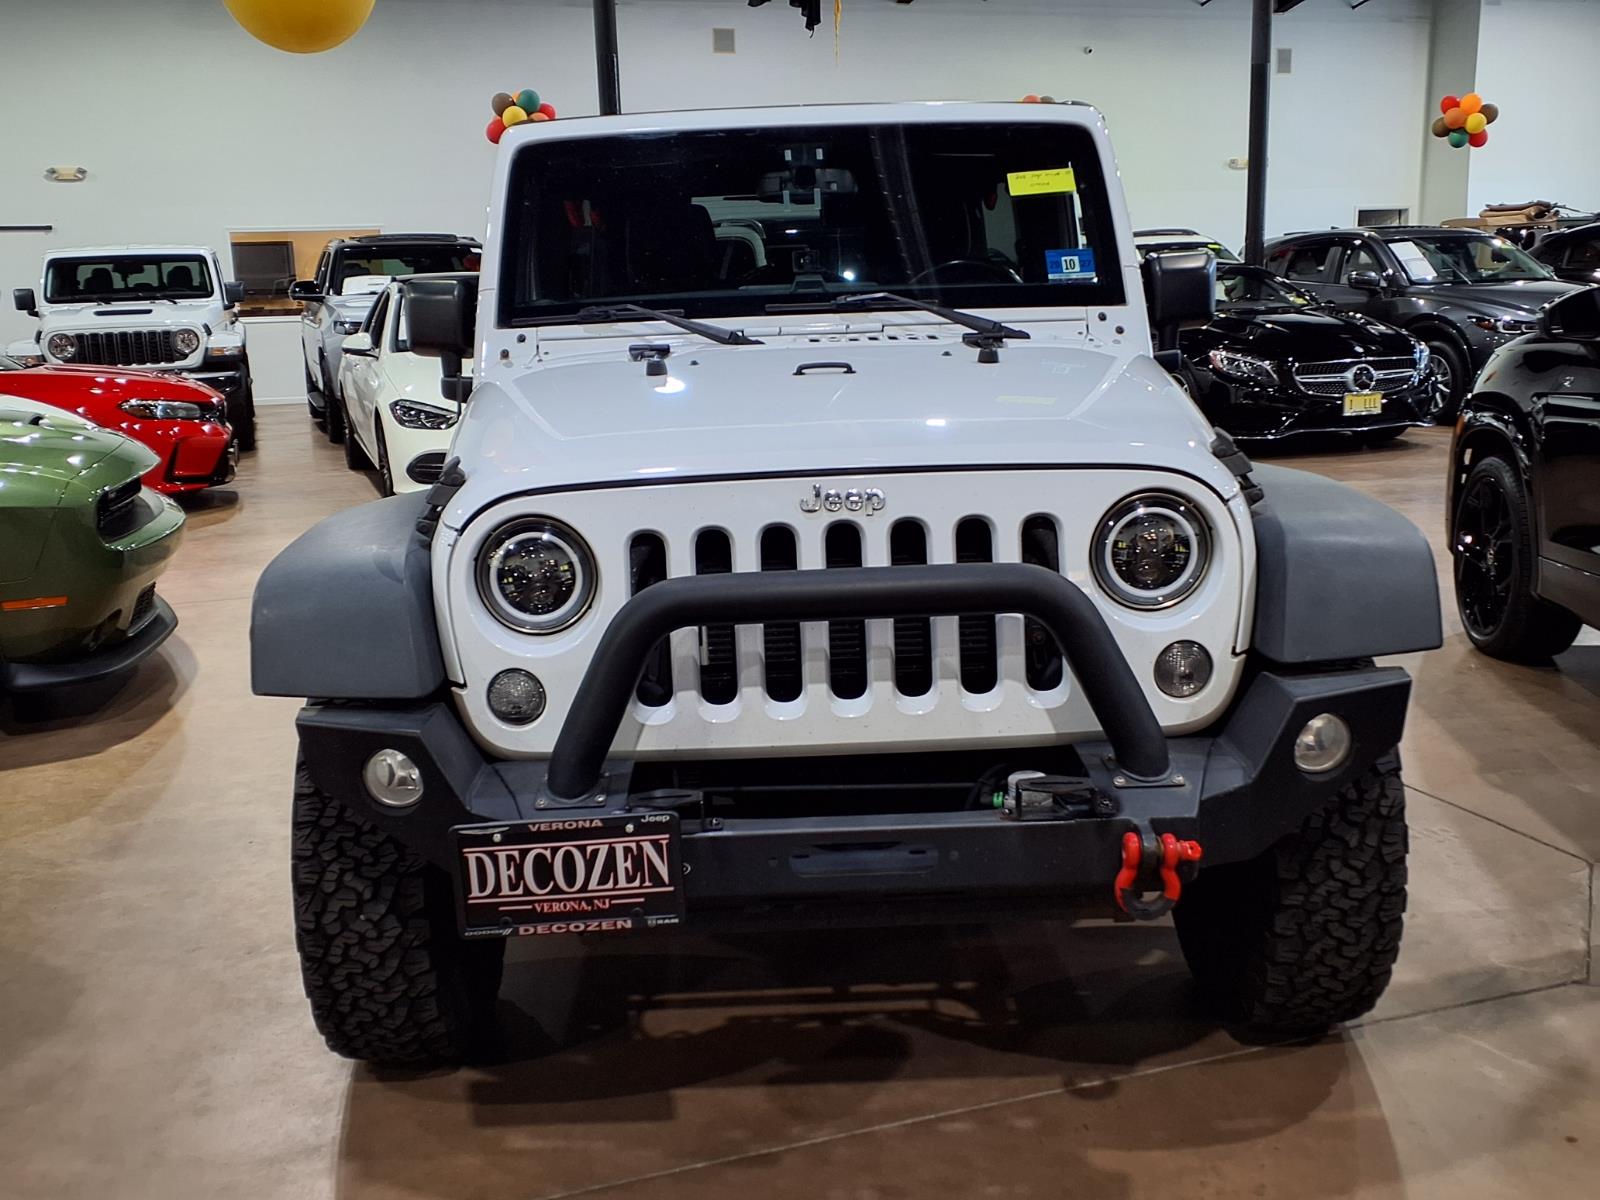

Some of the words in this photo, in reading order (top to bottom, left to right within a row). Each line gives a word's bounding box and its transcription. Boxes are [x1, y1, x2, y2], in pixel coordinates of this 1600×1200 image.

[1063, 258, 1076, 270] 10
[799, 483, 886, 516] Jeep
[528, 819, 603, 832] VERONA
[641, 814, 671, 824] Jeep
[464, 840, 670, 897] DECOZEN
[533, 900, 592, 913] VERONA,
[593, 898, 610, 910] NJ
[518, 920, 632, 936] DECOZEN
